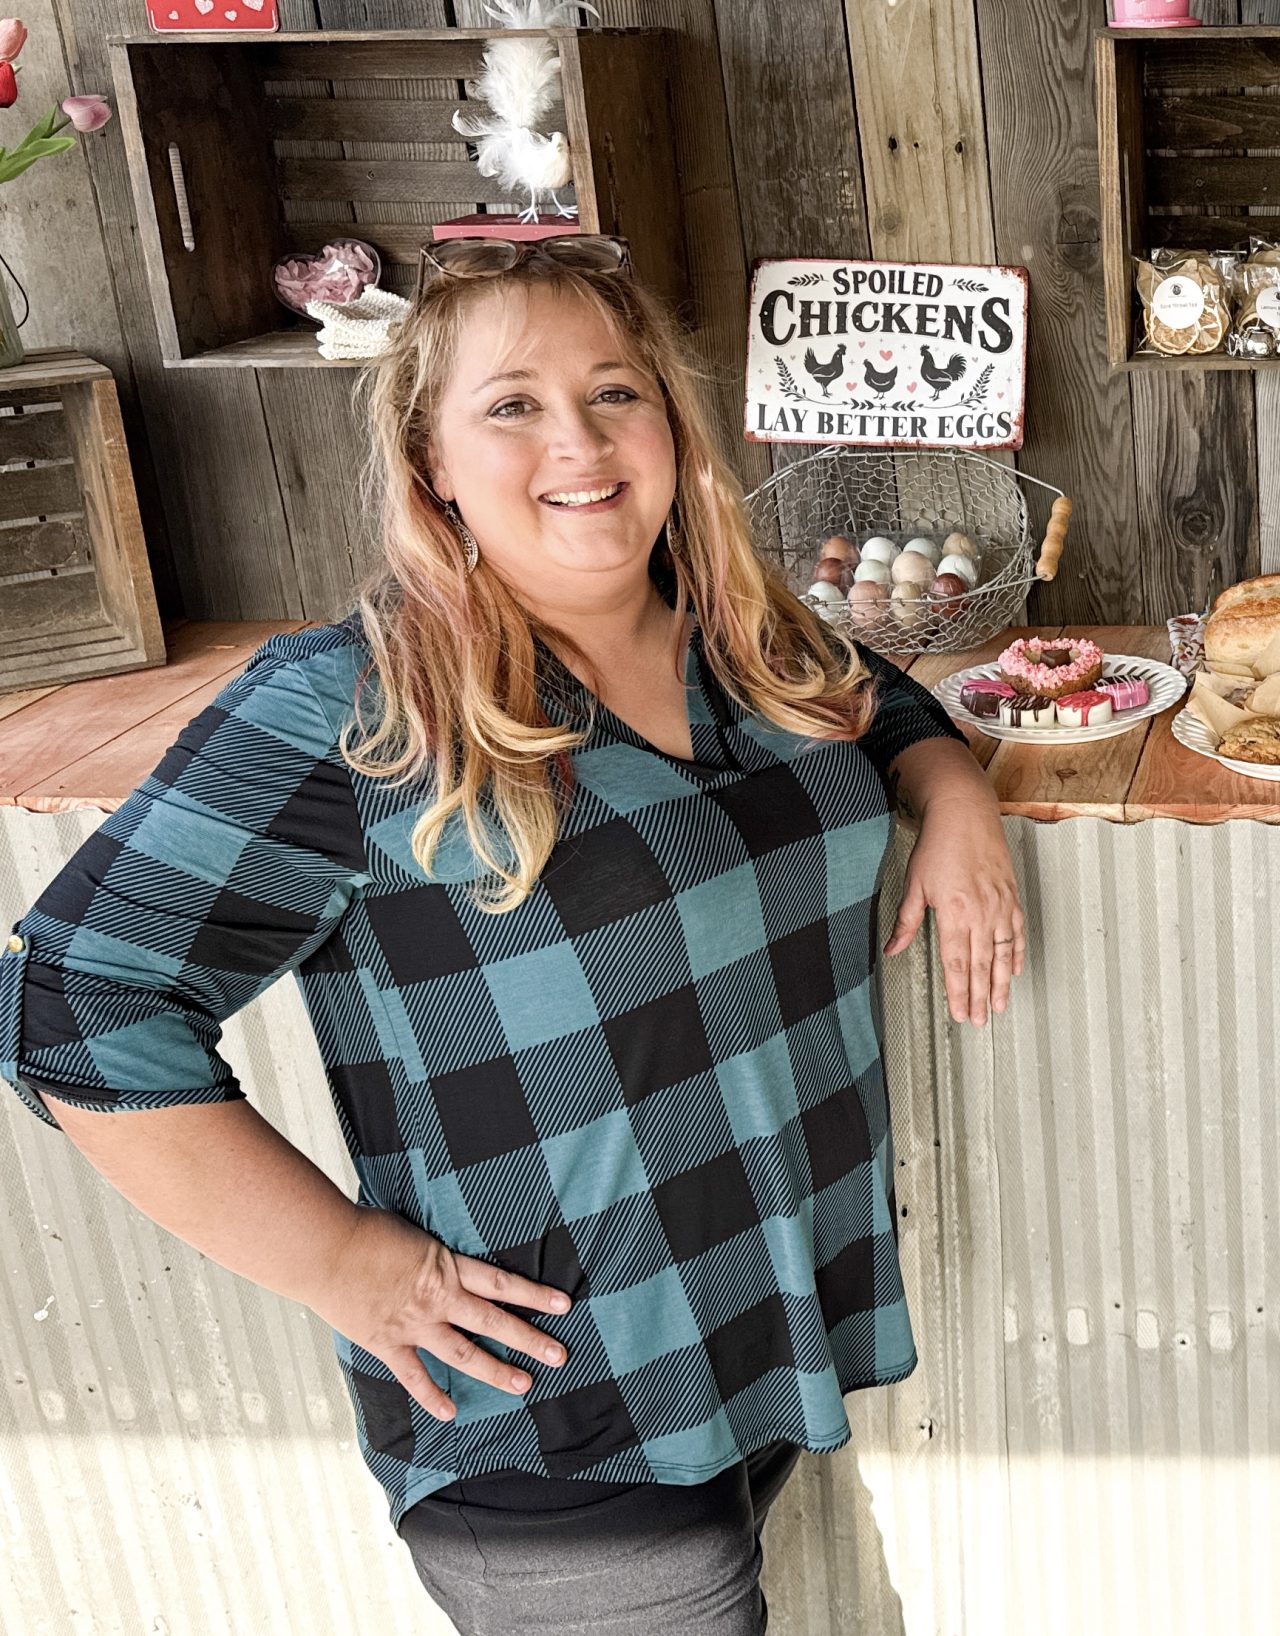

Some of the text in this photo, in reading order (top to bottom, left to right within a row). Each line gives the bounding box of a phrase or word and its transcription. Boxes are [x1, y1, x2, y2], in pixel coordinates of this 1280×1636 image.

[833, 267, 944, 298] SPOILED
[759, 289, 1014, 354] CHICKENS
[757, 403, 1013, 439] LAY BETTER EGGS
